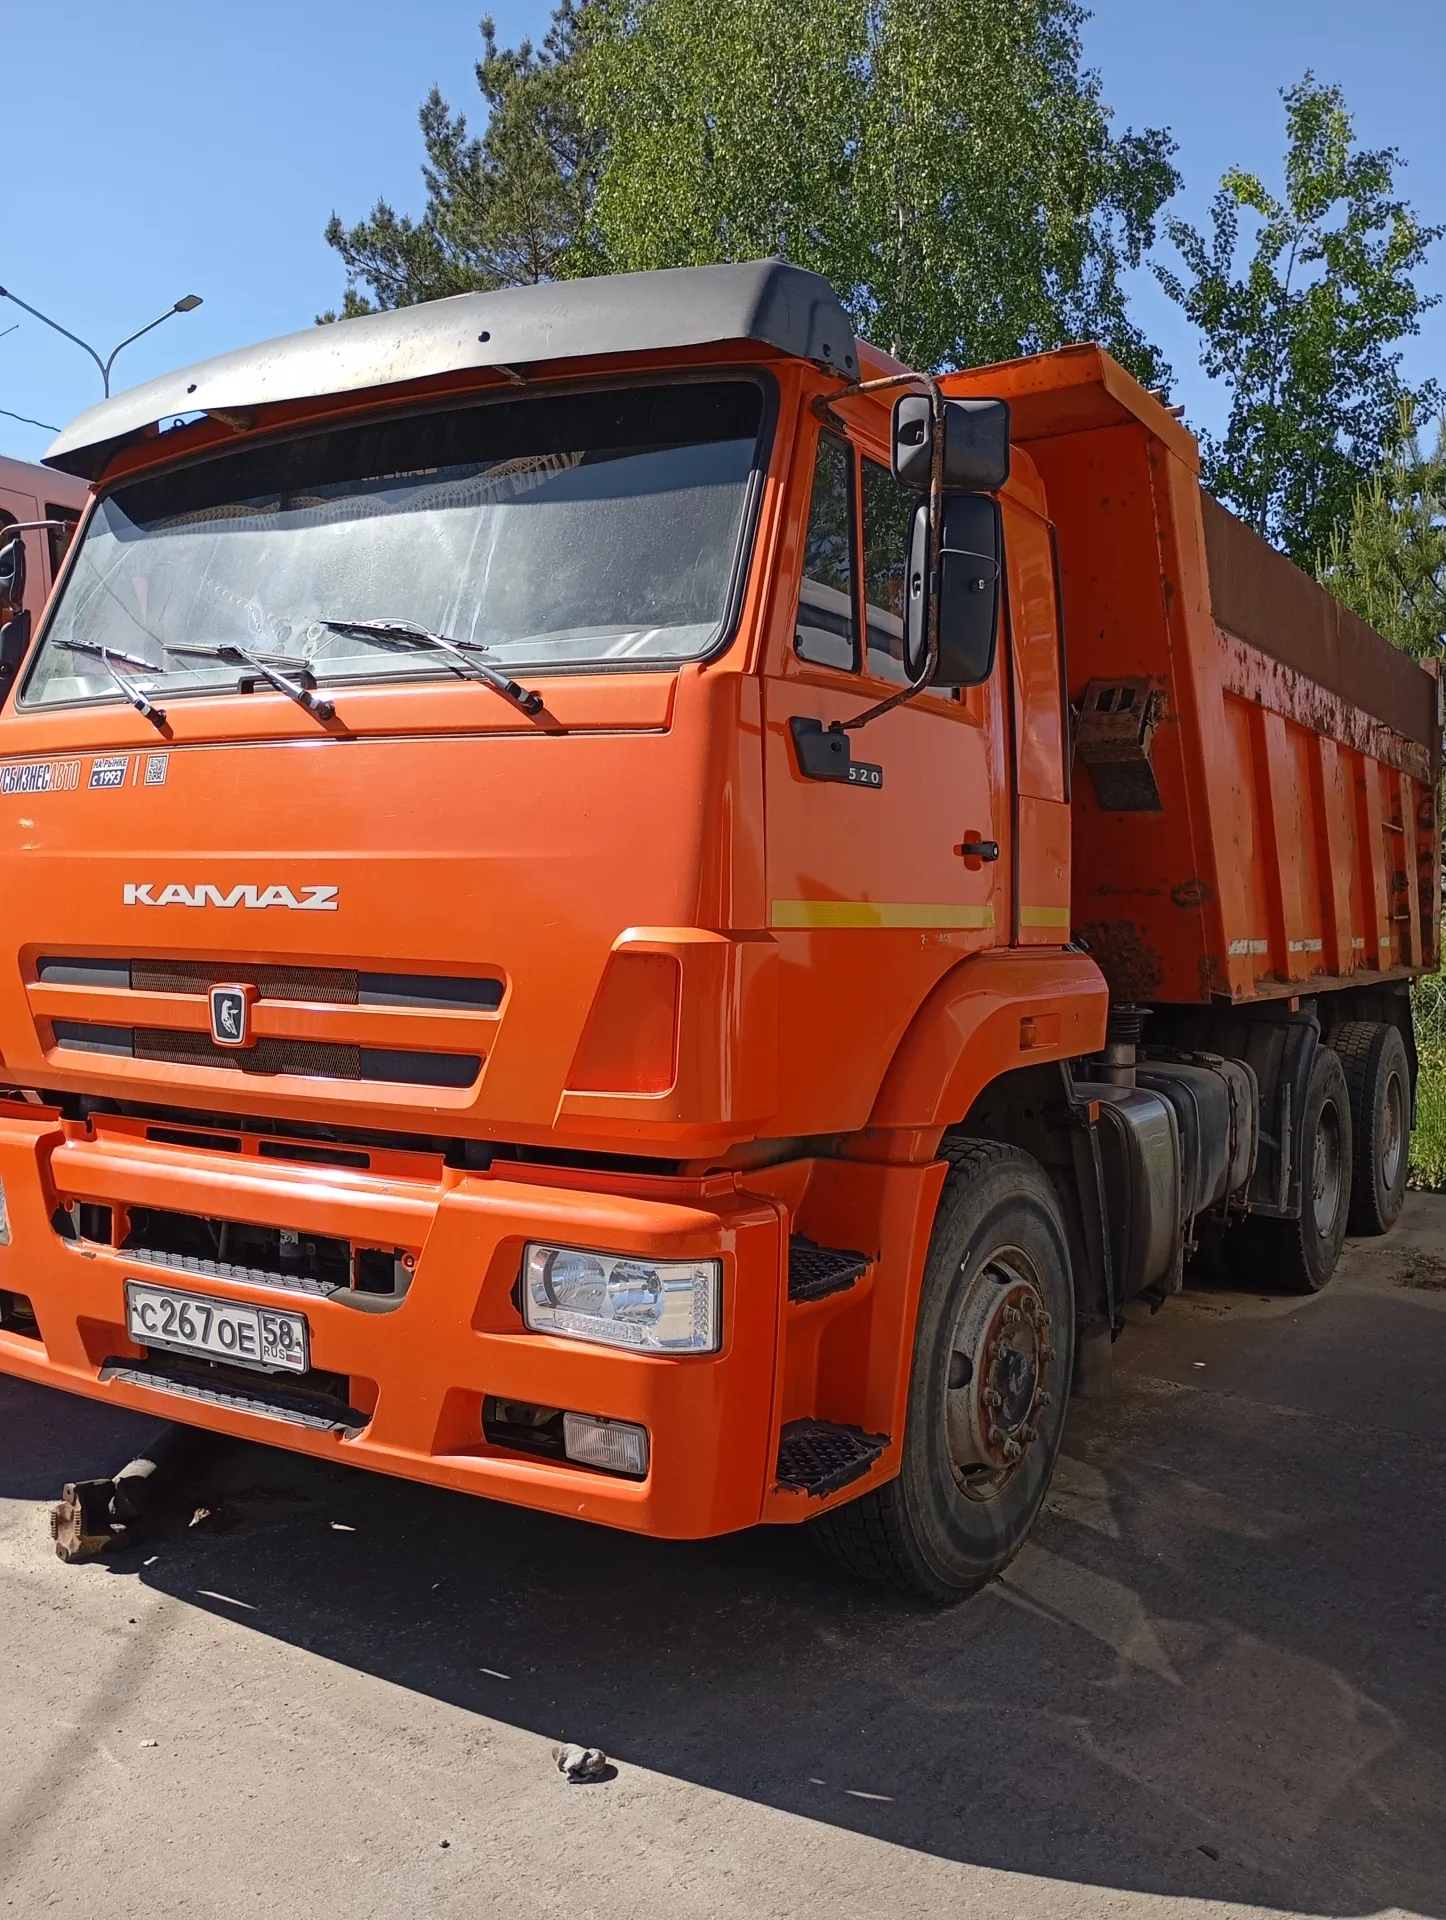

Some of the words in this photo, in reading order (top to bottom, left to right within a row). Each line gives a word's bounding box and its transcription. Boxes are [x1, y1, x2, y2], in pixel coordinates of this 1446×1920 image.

[103, 757, 128, 768] РЫНКЕ
[99, 770, 121, 785] 1993
[123, 883, 339, 911] KAMAZ
[262, 1314, 294, 1349] 58
[263, 1346, 286, 1360] RUS
